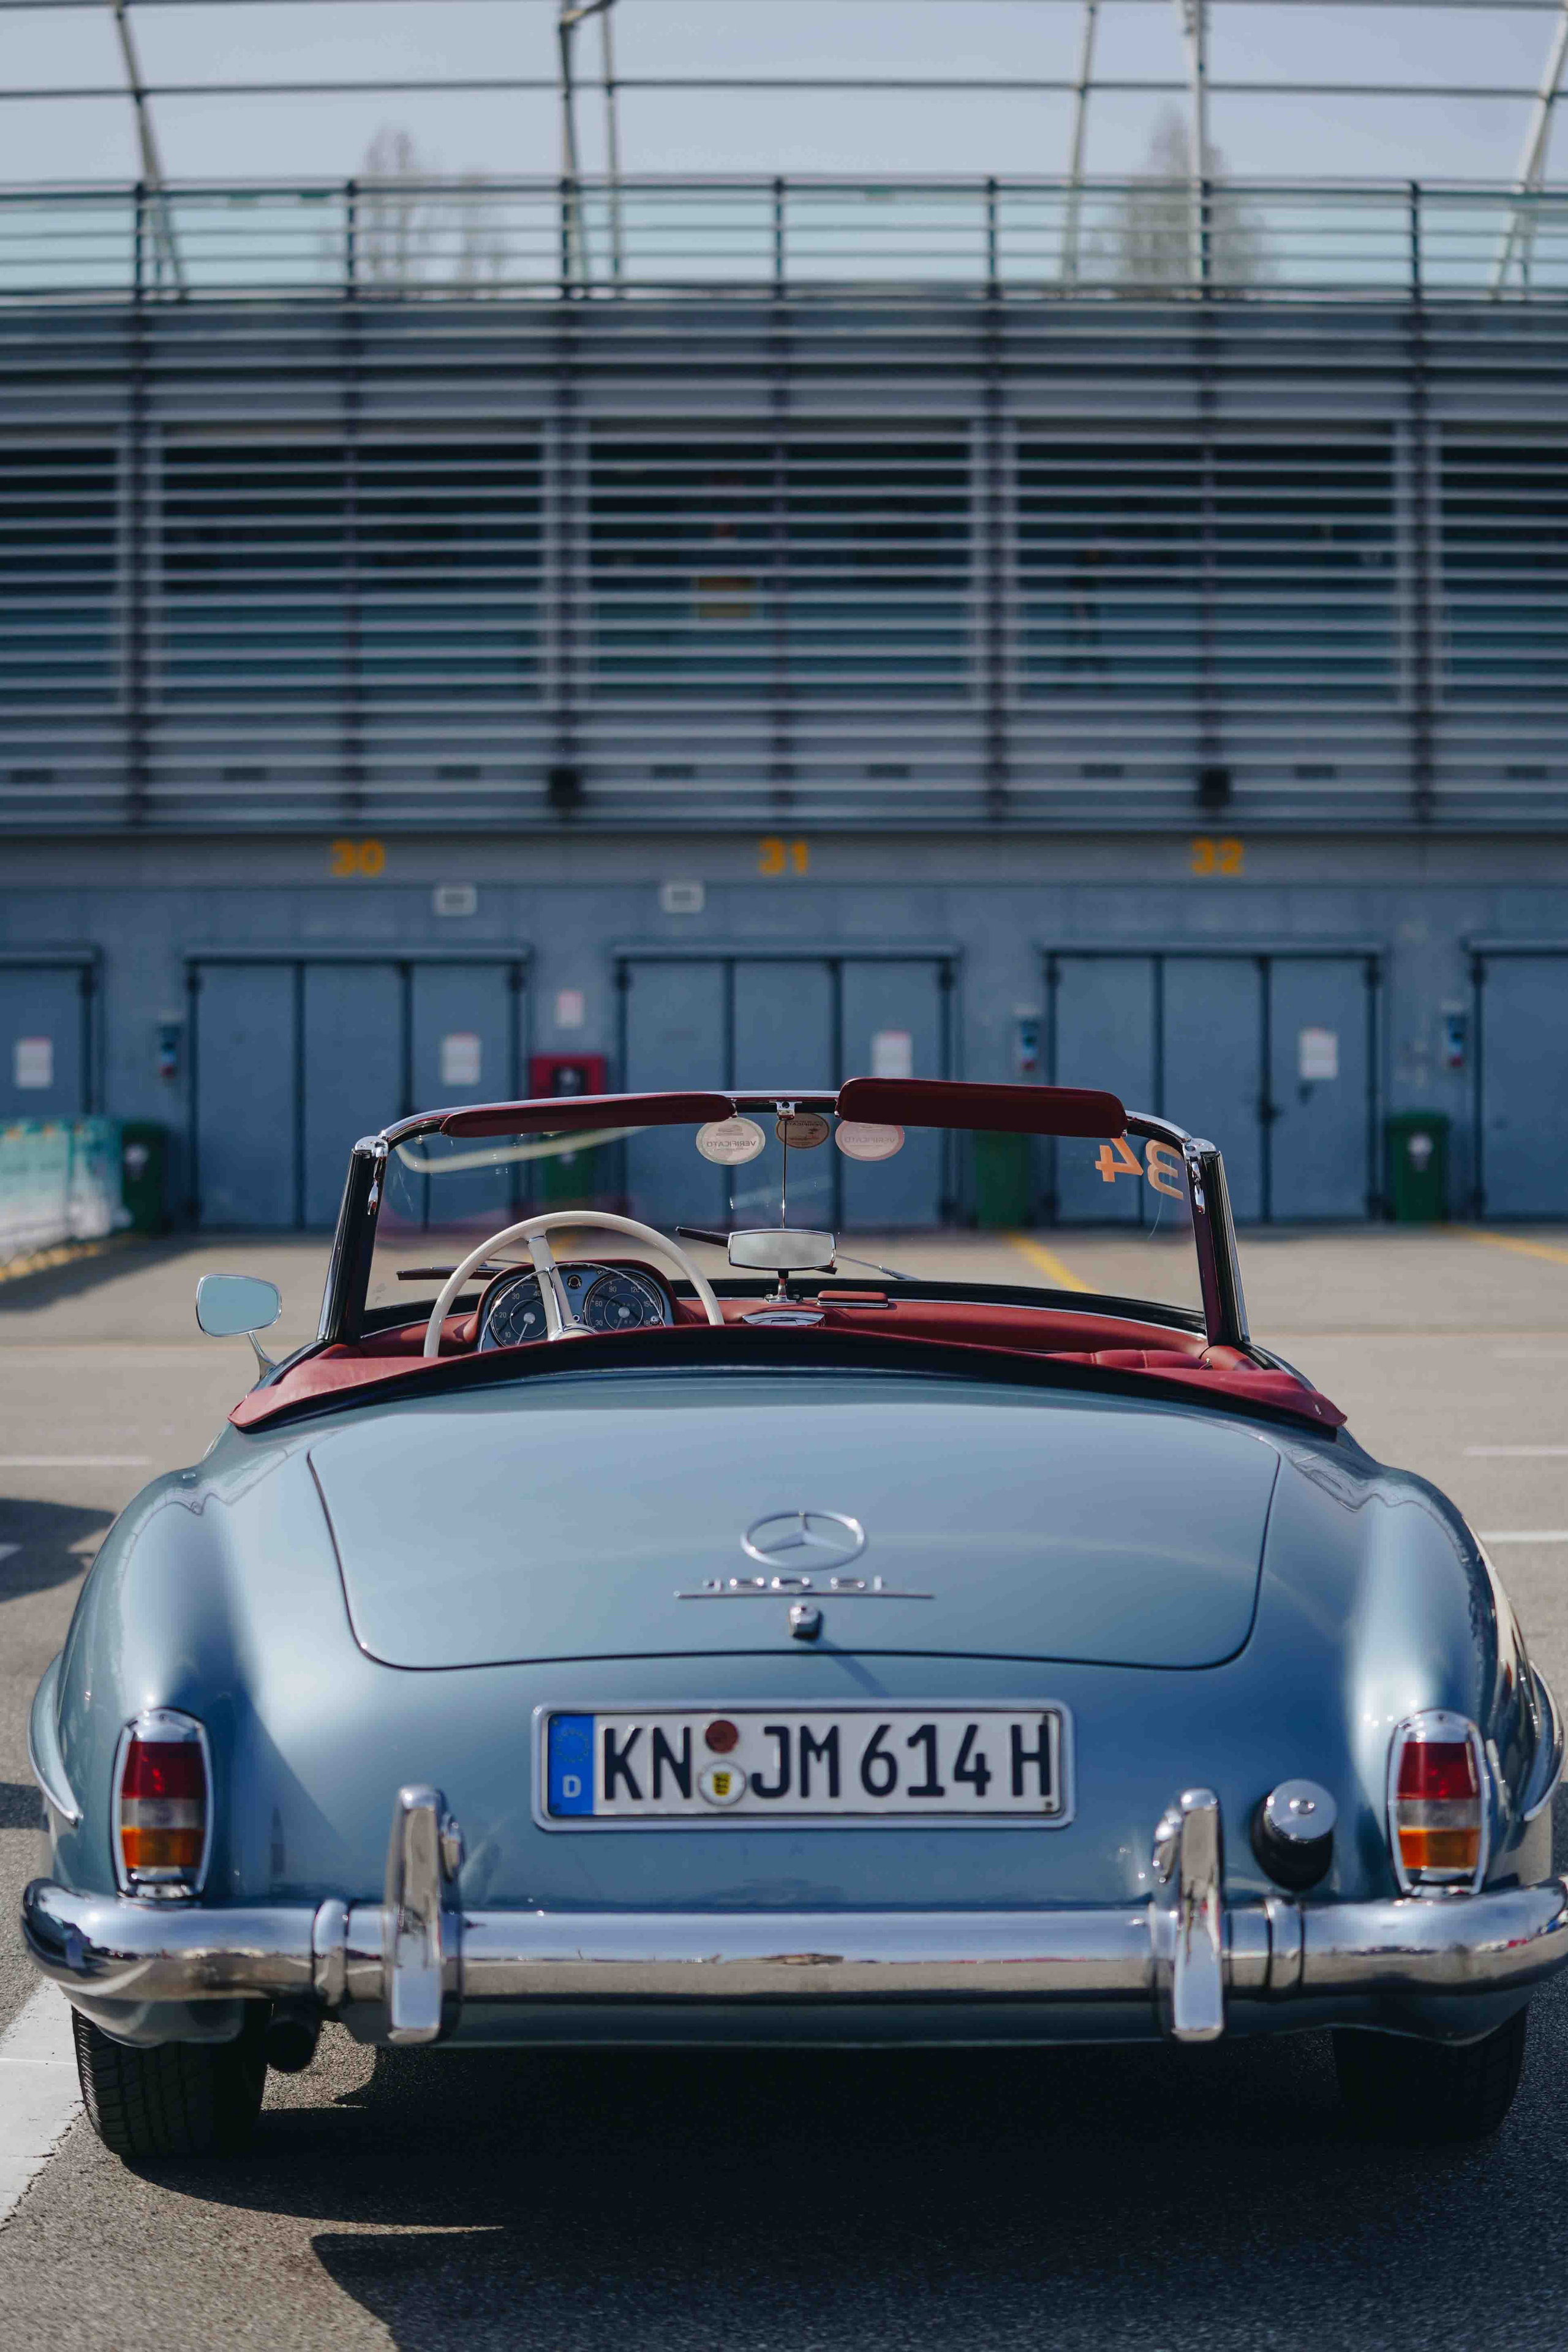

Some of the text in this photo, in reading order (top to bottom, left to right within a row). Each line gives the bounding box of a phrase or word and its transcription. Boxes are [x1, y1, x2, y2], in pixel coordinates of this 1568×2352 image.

[330, 839, 385, 878] 30
[758, 837, 809, 877] 31
[1190, 837, 1244, 877] 32
[604, 1724, 1051, 1800] KN JM 614 H
[562, 1774, 581, 1798] D
